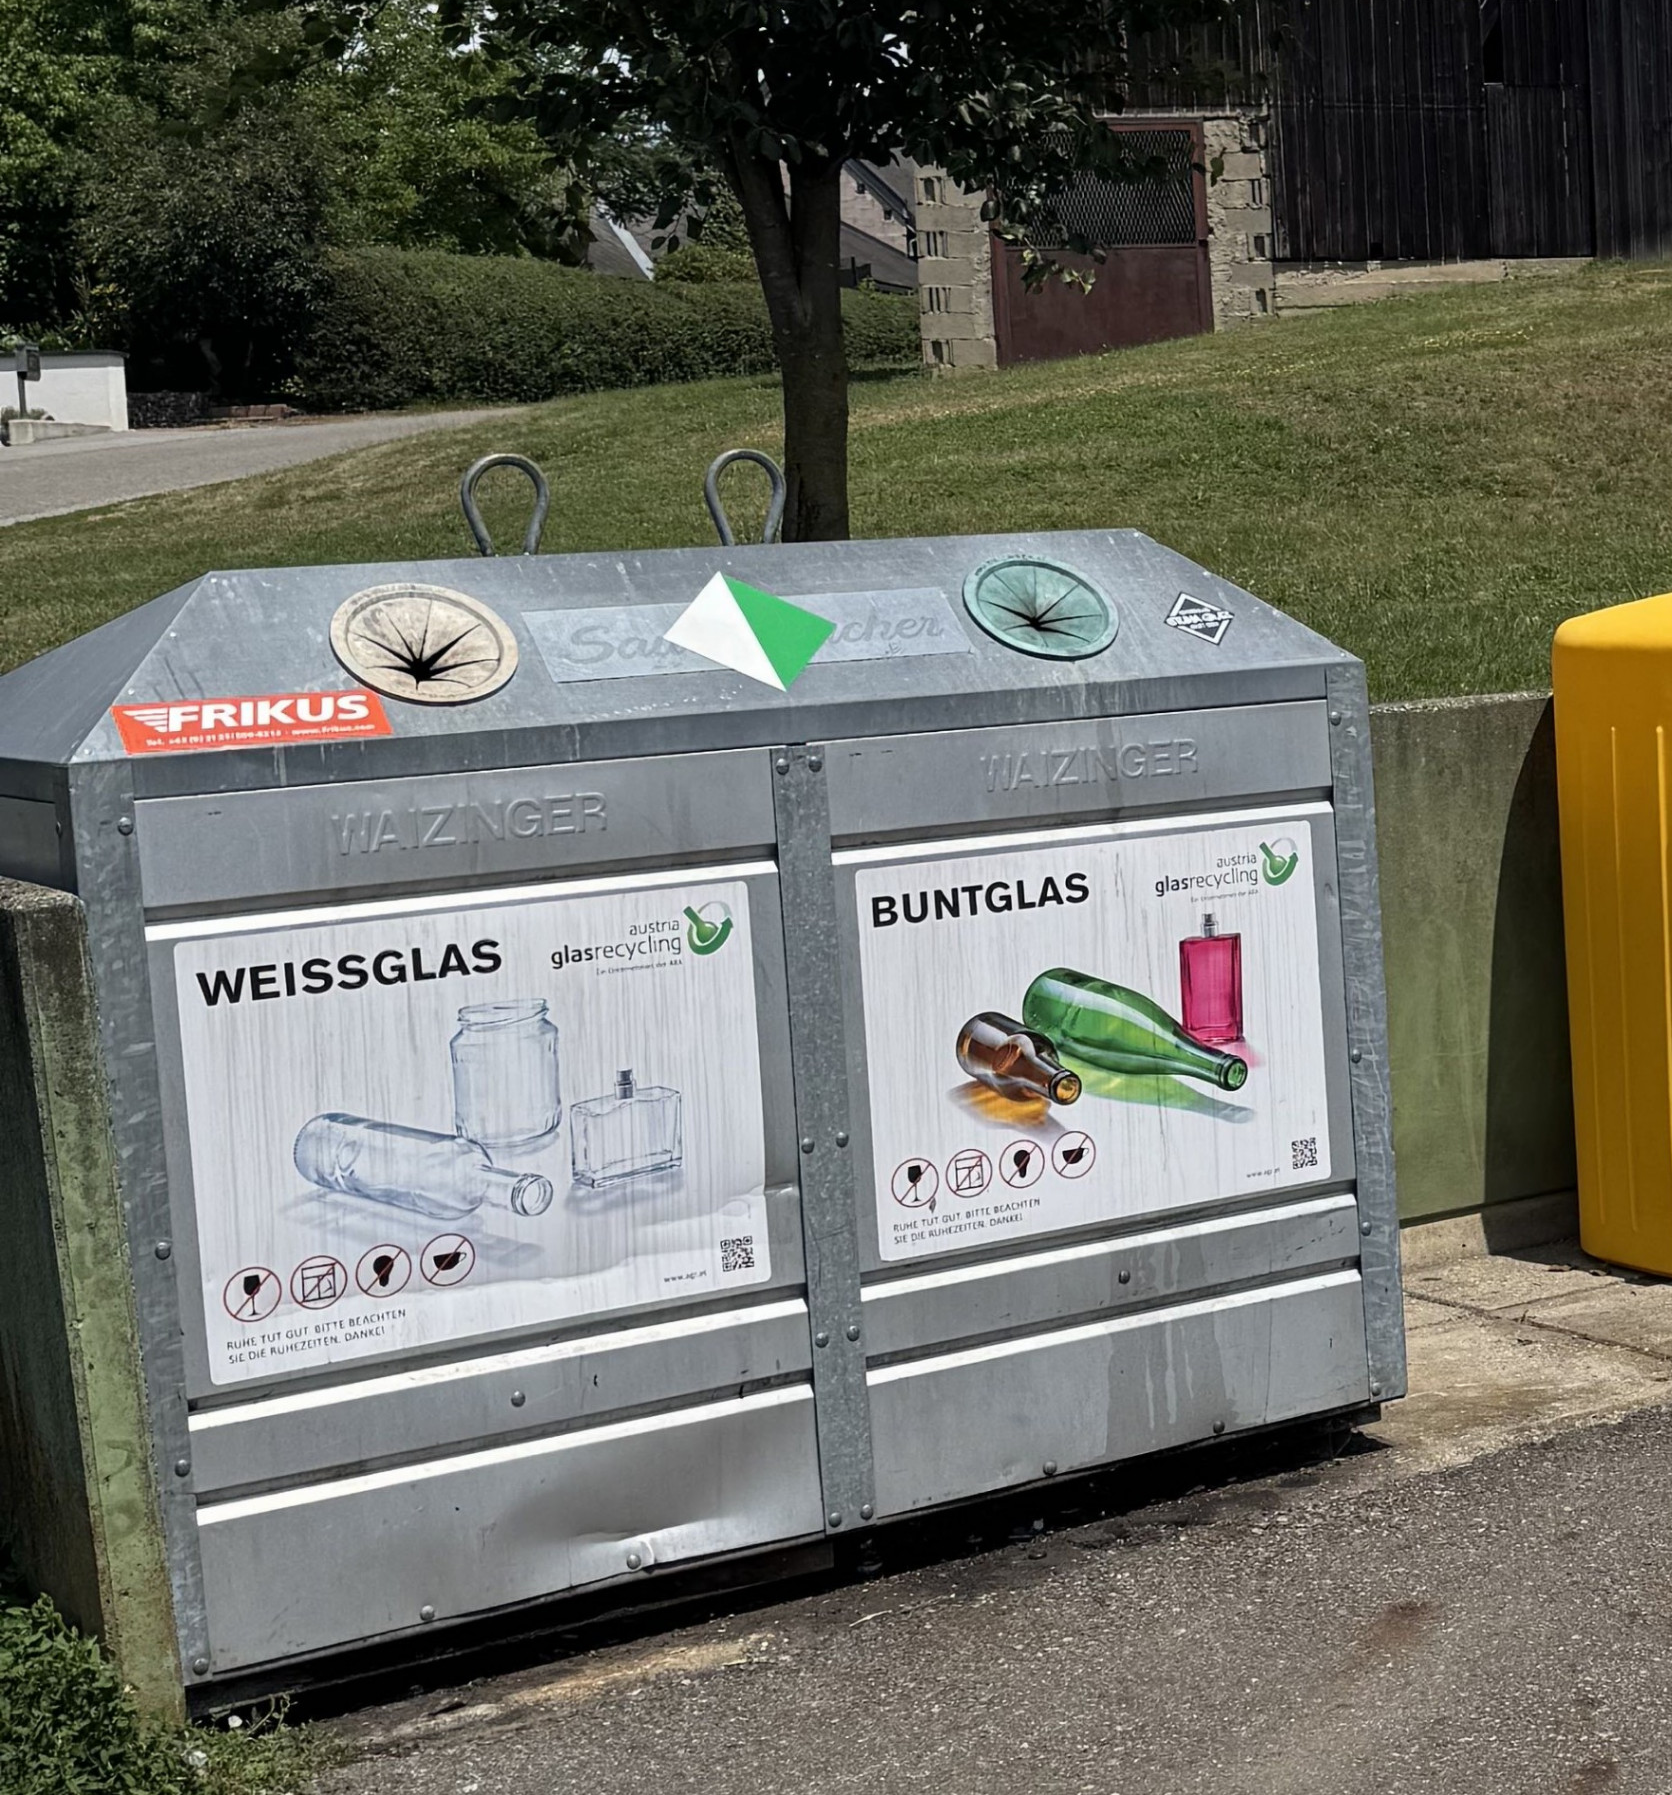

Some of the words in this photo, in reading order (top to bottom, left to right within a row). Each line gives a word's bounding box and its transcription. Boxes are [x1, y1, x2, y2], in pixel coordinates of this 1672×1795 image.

[168, 695, 369, 732] FRIKUS
[979, 739, 1198, 792] WAIZINGER
[330, 792, 608, 855] WAIZINGER
[1217, 853, 1256, 868] austria
[1155, 869, 1257, 897] glasrecycling
[871, 873, 1089, 928] BUNTGLAS
[630, 920, 679, 935] austria
[551, 936, 681, 969] glasrecycling
[196, 939, 502, 1006] WEISSGLAS
[894, 1221, 918, 1232] RUHE
[922, 1217, 938, 1227] TUT
[966, 1207, 990, 1219] BITTE
[994, 1198, 1040, 1214] BEACHTEN
[894, 1235, 907, 1244] SIE
[911, 1232, 925, 1242] DIE
[227, 1337, 256, 1350] RUHE
[261, 1332, 281, 1344] TUT
[315, 1320, 345, 1333] BITTE
[349, 1309, 406, 1327] BEACHTEN
[229, 1353, 245, 1364] SIE
[249, 1350, 266, 1360] DIE
